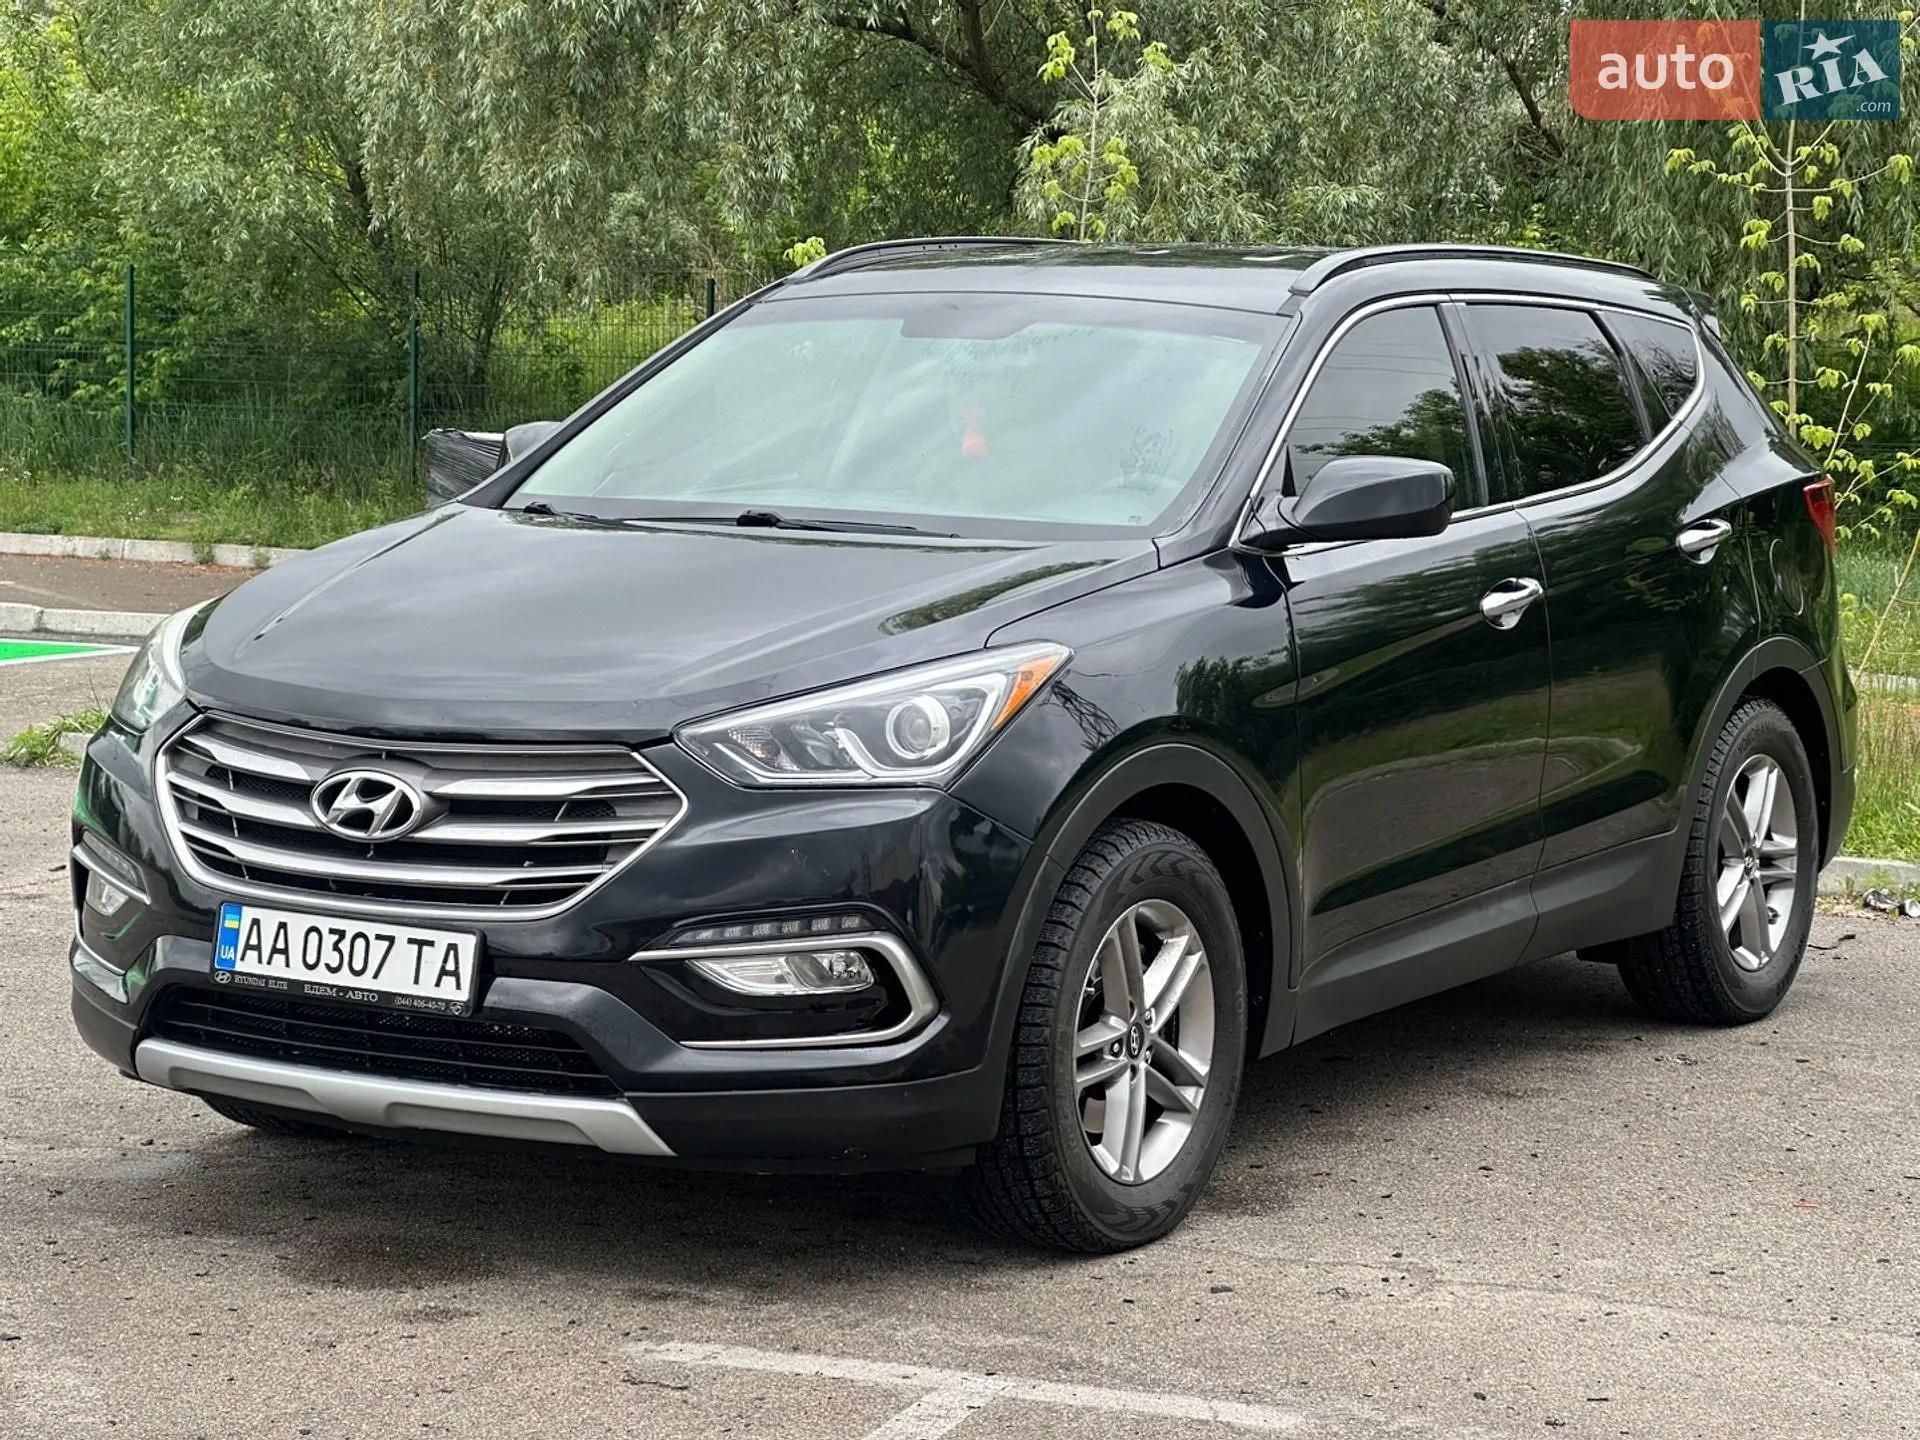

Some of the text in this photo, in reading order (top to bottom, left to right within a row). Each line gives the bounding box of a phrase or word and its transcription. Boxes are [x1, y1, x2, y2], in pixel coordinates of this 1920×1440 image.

[220, 944, 235, 960] UA
[240, 917, 462, 990] AA 0307 TA
[234, 974, 289, 990] HYUNDAI ELITE
[345, 990, 379, 1002] АВТО
